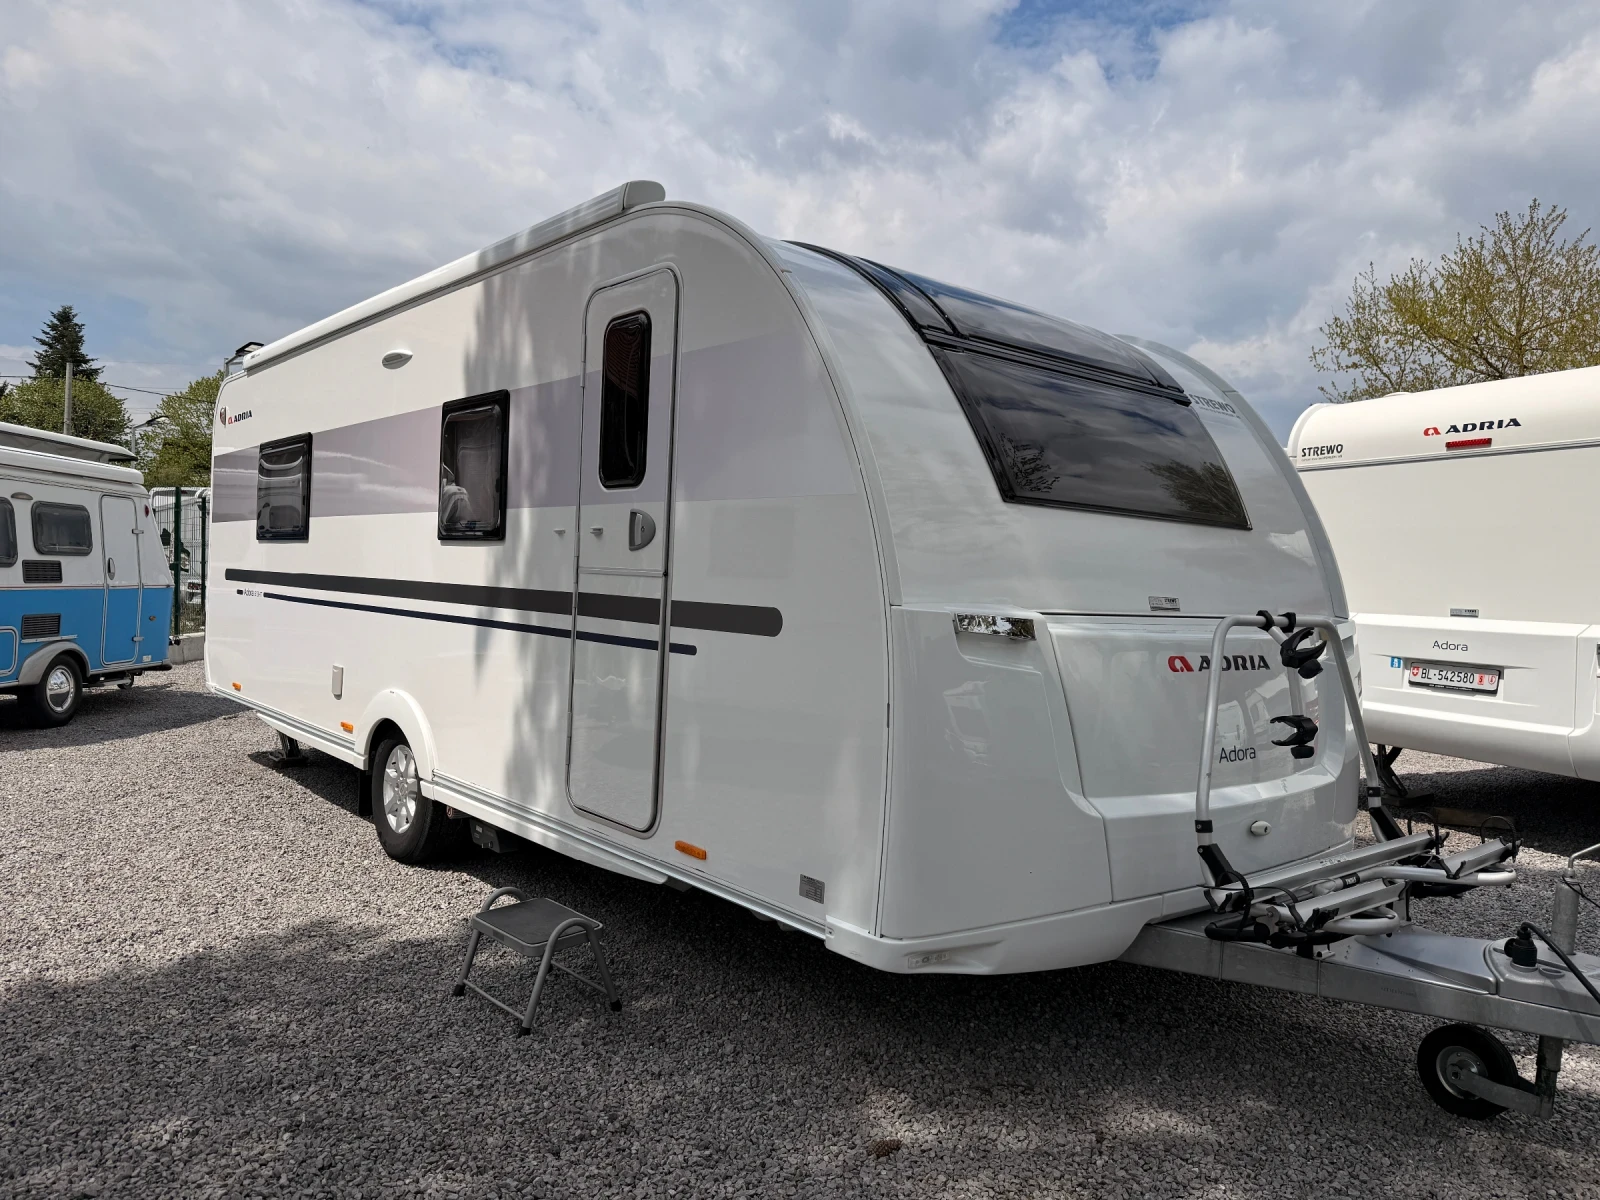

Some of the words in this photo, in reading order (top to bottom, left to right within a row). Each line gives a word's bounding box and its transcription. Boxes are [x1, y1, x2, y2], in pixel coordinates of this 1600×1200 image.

[1188, 394, 1236, 414] STREWO
[233, 409, 253, 423] ADRIA
[1445, 418, 1522, 434] ADRIA
[1301, 443, 1344, 457] STREWO
[1432, 640, 1469, 652] Adora
[1218, 745, 1256, 764] Adora
